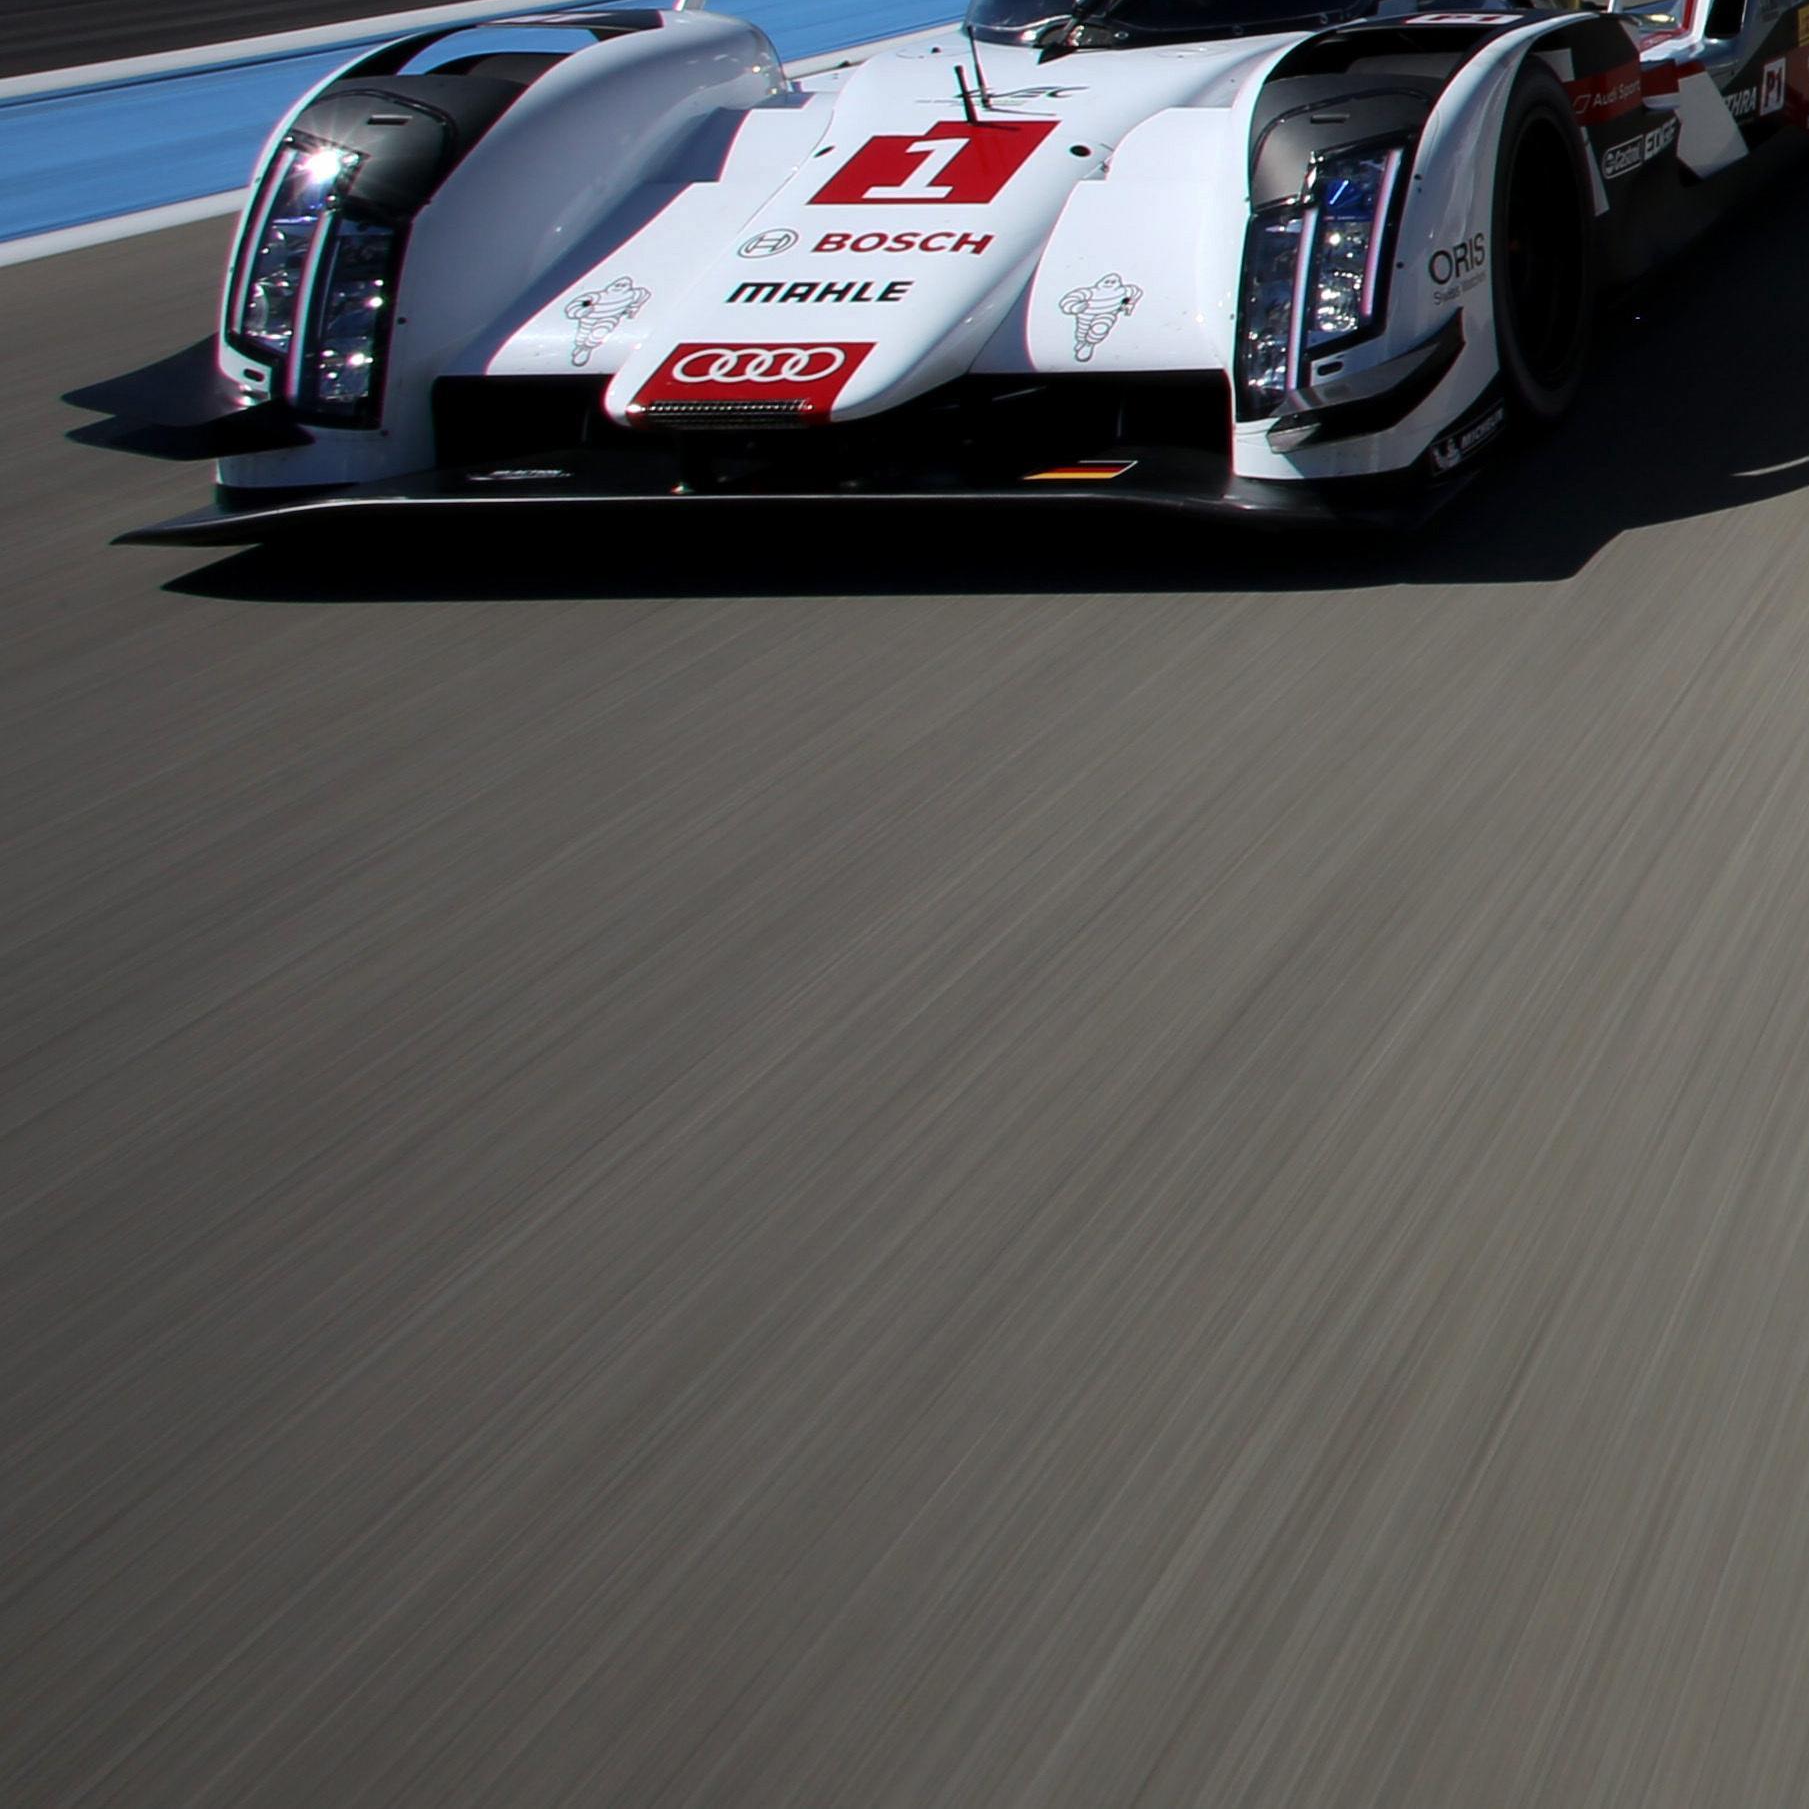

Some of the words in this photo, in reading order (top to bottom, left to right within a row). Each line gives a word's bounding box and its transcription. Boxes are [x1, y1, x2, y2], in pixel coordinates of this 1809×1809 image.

[1765, 66, 1783, 107] P1
[860, 137, 971, 199] 1
[811, 232, 995, 255] BOSCH
[1429, 233, 1485, 284] ORIS
[726, 281, 914, 303] MAHLE
